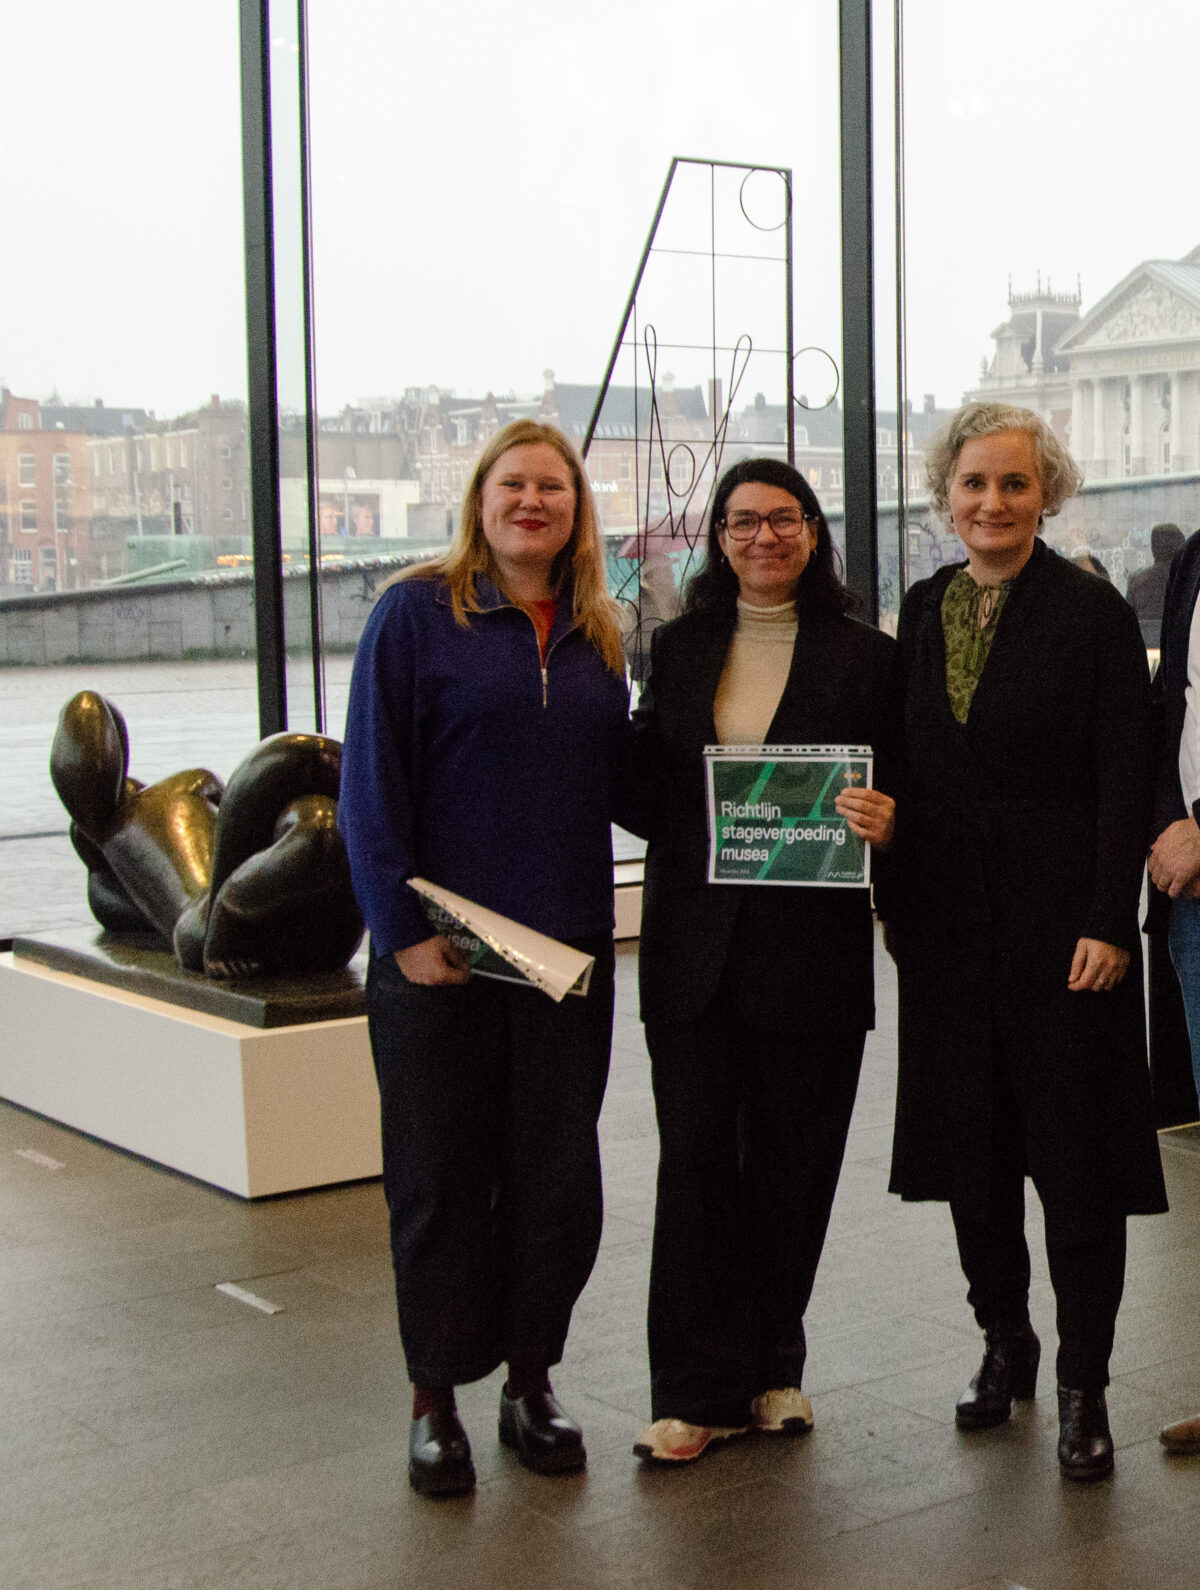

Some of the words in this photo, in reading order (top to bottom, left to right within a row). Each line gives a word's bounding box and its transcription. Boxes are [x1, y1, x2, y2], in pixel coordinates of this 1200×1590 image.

[721, 802, 781, 821] Richtlijn
[721, 826, 846, 845] stagevergoeding
[721, 848, 769, 861] musea
